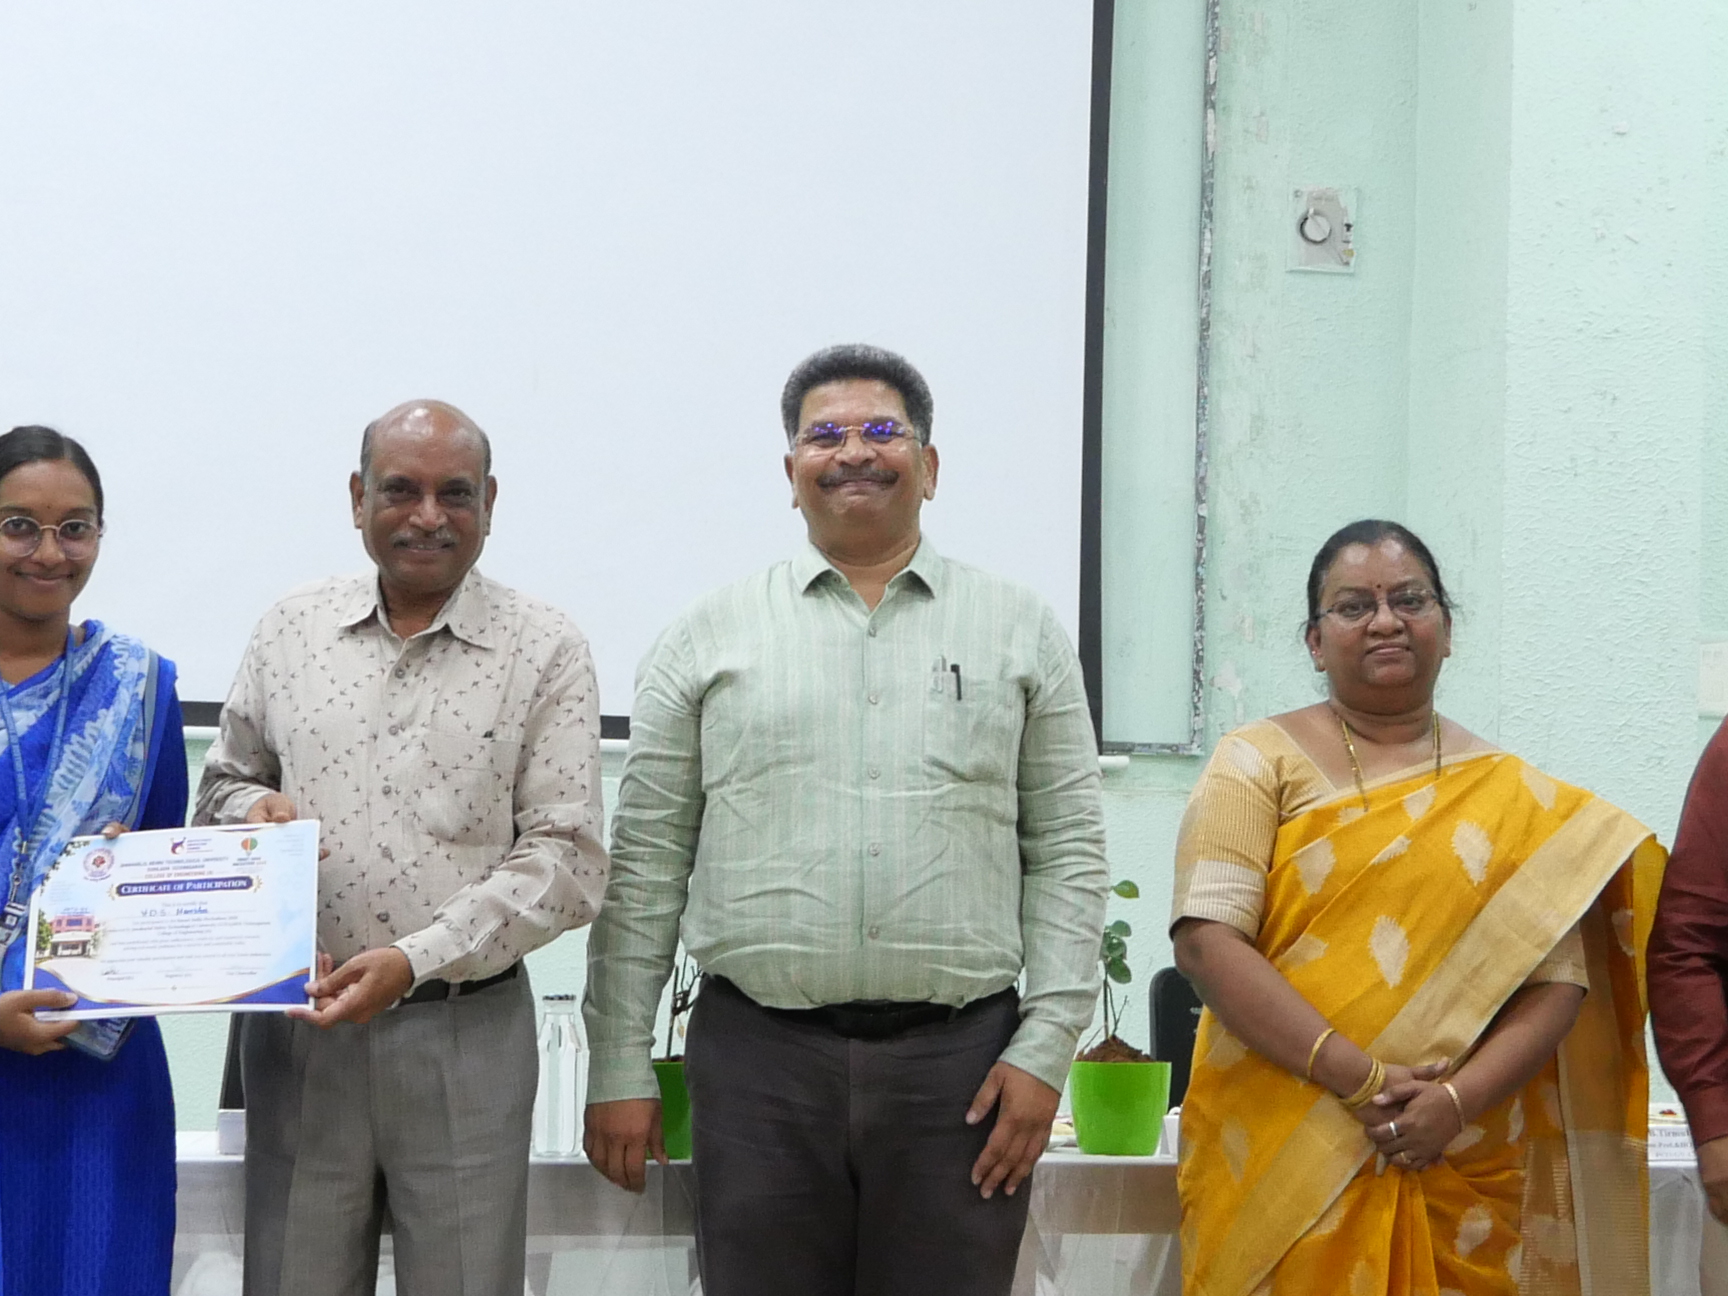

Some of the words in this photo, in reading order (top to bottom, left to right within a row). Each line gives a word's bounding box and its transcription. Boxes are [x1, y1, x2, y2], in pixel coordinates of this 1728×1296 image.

[121, 883, 171, 894] CERTIFICATE
[173, 883, 183, 891] OF
[185, 879, 248, 891] PARTICIPATION
